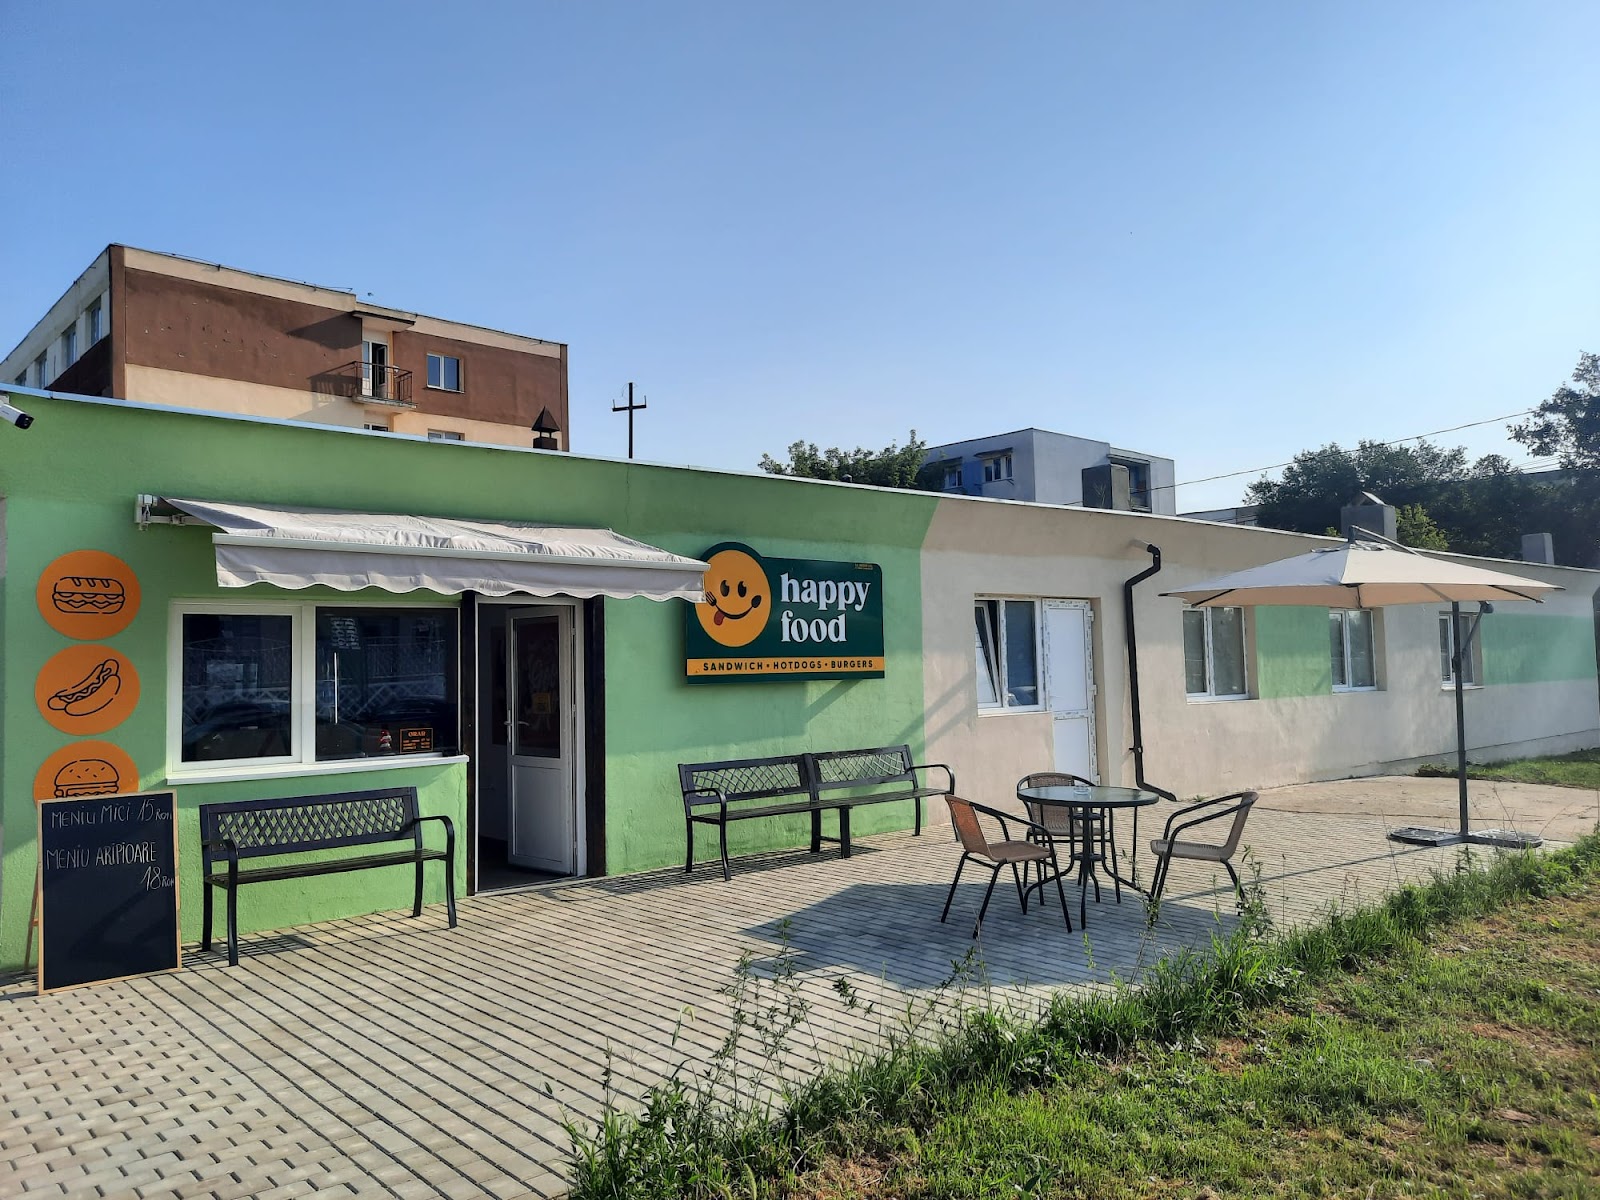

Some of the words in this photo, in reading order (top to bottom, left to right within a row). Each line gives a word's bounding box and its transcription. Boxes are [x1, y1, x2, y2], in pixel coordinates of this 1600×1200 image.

[780, 572, 871, 611] happy
[780, 610, 847, 643] food
[703, 662, 763, 671] SANDWICH
[773, 661, 822, 670] HOTDOGS
[831, 660, 873, 669] BURGERS
[137, 799, 154, 822] 15
[141, 866, 161, 891] 18
